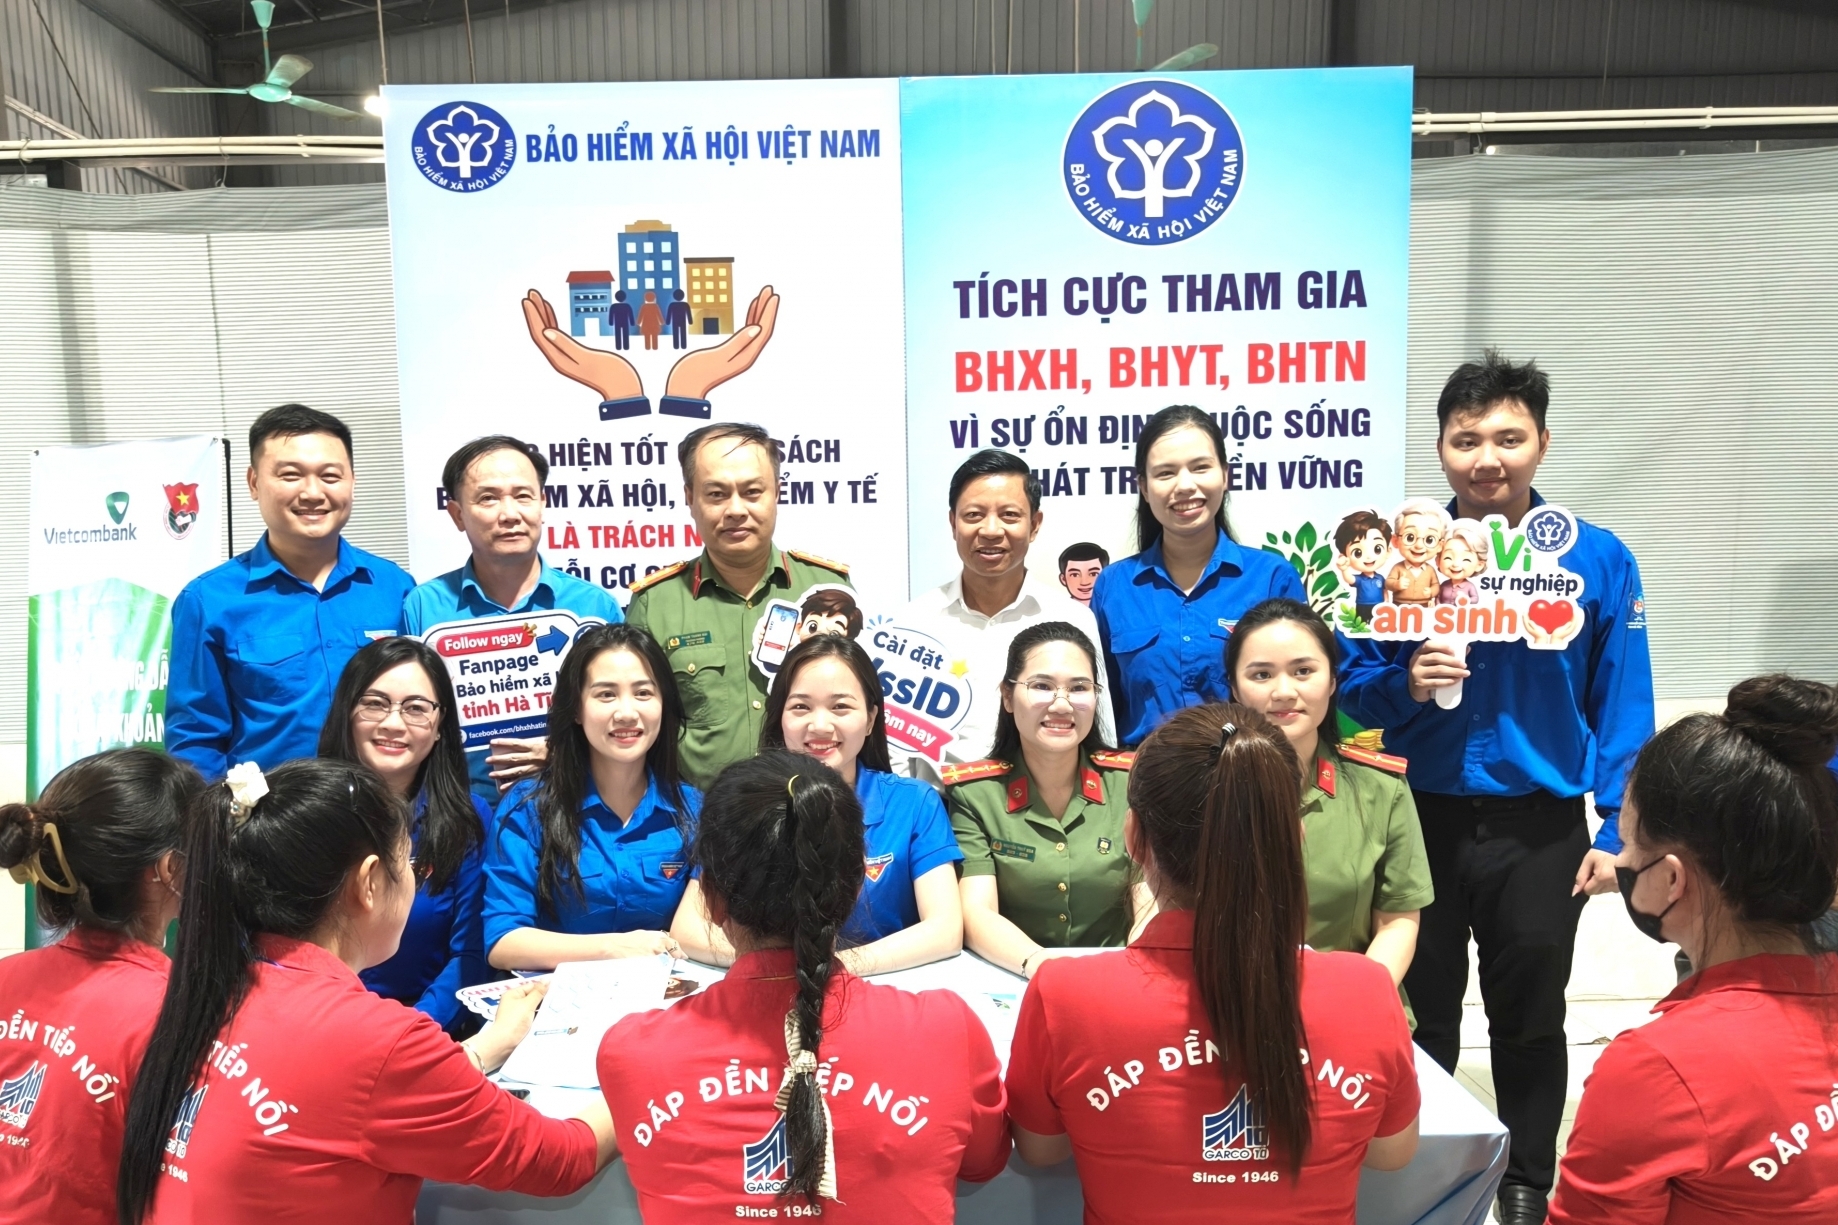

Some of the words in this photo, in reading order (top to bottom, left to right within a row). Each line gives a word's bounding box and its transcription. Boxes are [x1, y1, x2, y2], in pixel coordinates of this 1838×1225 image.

[525, 124, 578, 163] BẢO
[587, 121, 653, 162] HIỂM
[662, 126, 698, 161] XÃ
[705, 125, 749, 166] HỘI
[757, 124, 812, 165] VIỆT
[820, 129, 881, 158] NAM
[414, 146, 427, 166] BẢO
[423, 165, 448, 187] HIỂM
[450, 180, 464, 191] XÃ
[467, 178, 489, 190] HỘI
[489, 161, 509, 182] VIỆT
[504, 139, 514, 161] NAM
[1070, 163, 1091, 197] BẢO
[1083, 197, 1125, 233] HIỂM
[1127, 222, 1150, 239] XÃ
[1157, 218, 1193, 239] HỘI
[1193, 187, 1228, 223] VIỆT
[1220, 149, 1238, 186] NAM
[953, 271, 1047, 319] TÍCH
[1063, 271, 1147, 324] CỰC
[1161, 271, 1281, 314] THAM
[1297, 269, 1368, 309] GIA
[955, 348, 1093, 395] BHXH,
[1109, 343, 1230, 391] BHYT,
[1247, 340, 1367, 384] BHTN
[950, 413, 978, 449] VÌ
[990, 414, 1036, 453] SỰ
[1044, 405, 1087, 446] ỔN
[1098, 414, 1154, 450] ĐỊN
[1209, 405, 1272, 447] UỘC
[1284, 398, 1371, 438] SỐNG
[549, 437, 612, 471] HIỆN
[621, 433, 668, 466] TỐT
[577, 479, 614, 508] XÃ
[622, 478, 675, 512] HỘI,
[777, 471, 814, 504] ỂM
[823, 481, 839, 504] Y
[847, 472, 879, 503] TẾ
[1031, 461, 1090, 497] HÁT
[1227, 452, 1267, 491] ỀN
[1280, 454, 1363, 490] VỮNG
[44, 522, 138, 544] Vietcombank
[548, 521, 580, 549] LÀ
[588, 520, 674, 549] TRÁCH
[601, 563, 636, 589] CƠ
[1480, 575, 1506, 595] sự
[1510, 573, 1578, 596] nghiệp
[1374, 607, 1422, 634] an
[1434, 597, 1517, 634] sinh
[444, 636, 488, 651] Follow
[491, 632, 524, 647] ngay
[873, 630, 908, 656] Cài
[909, 645, 944, 670] đặt
[459, 654, 539, 676] Fanpage
[456, 683, 486, 698] Bảo
[490, 675, 528, 694] hiểm
[533, 673, 552, 687] xã
[462, 700, 500, 719] tỉnh
[505, 694, 530, 713] Hà
[884, 709, 905, 730] ôm
[906, 723, 937, 747] nay
[43, 1025, 75, 1058] TIẾP
[72, 1055, 119, 1103] NỐI
[210, 1041, 248, 1079] TIẾP
[241, 1077, 298, 1136] NỐI
[633, 1090, 685, 1147] ĐÁP
[699, 1058, 769, 1103] ĐỀN
[815, 1056, 854, 1097] ẾP
[862, 1082, 929, 1136] NỐI
[1086, 1059, 1145, 1111] ĐÁP
[1317, 1058, 1373, 1110] NỐI
[1204, 1150, 1250, 1159] GARCO
[1748, 1122, 1810, 1181] ĐÁP
[168, 1164, 188, 1182] 1946
[1192, 1171, 1236, 1183] Since
[1241, 1171, 1279, 1183] 1946
[735, 1205, 778, 1217] Since
[783, 1204, 822, 1217] 1946
